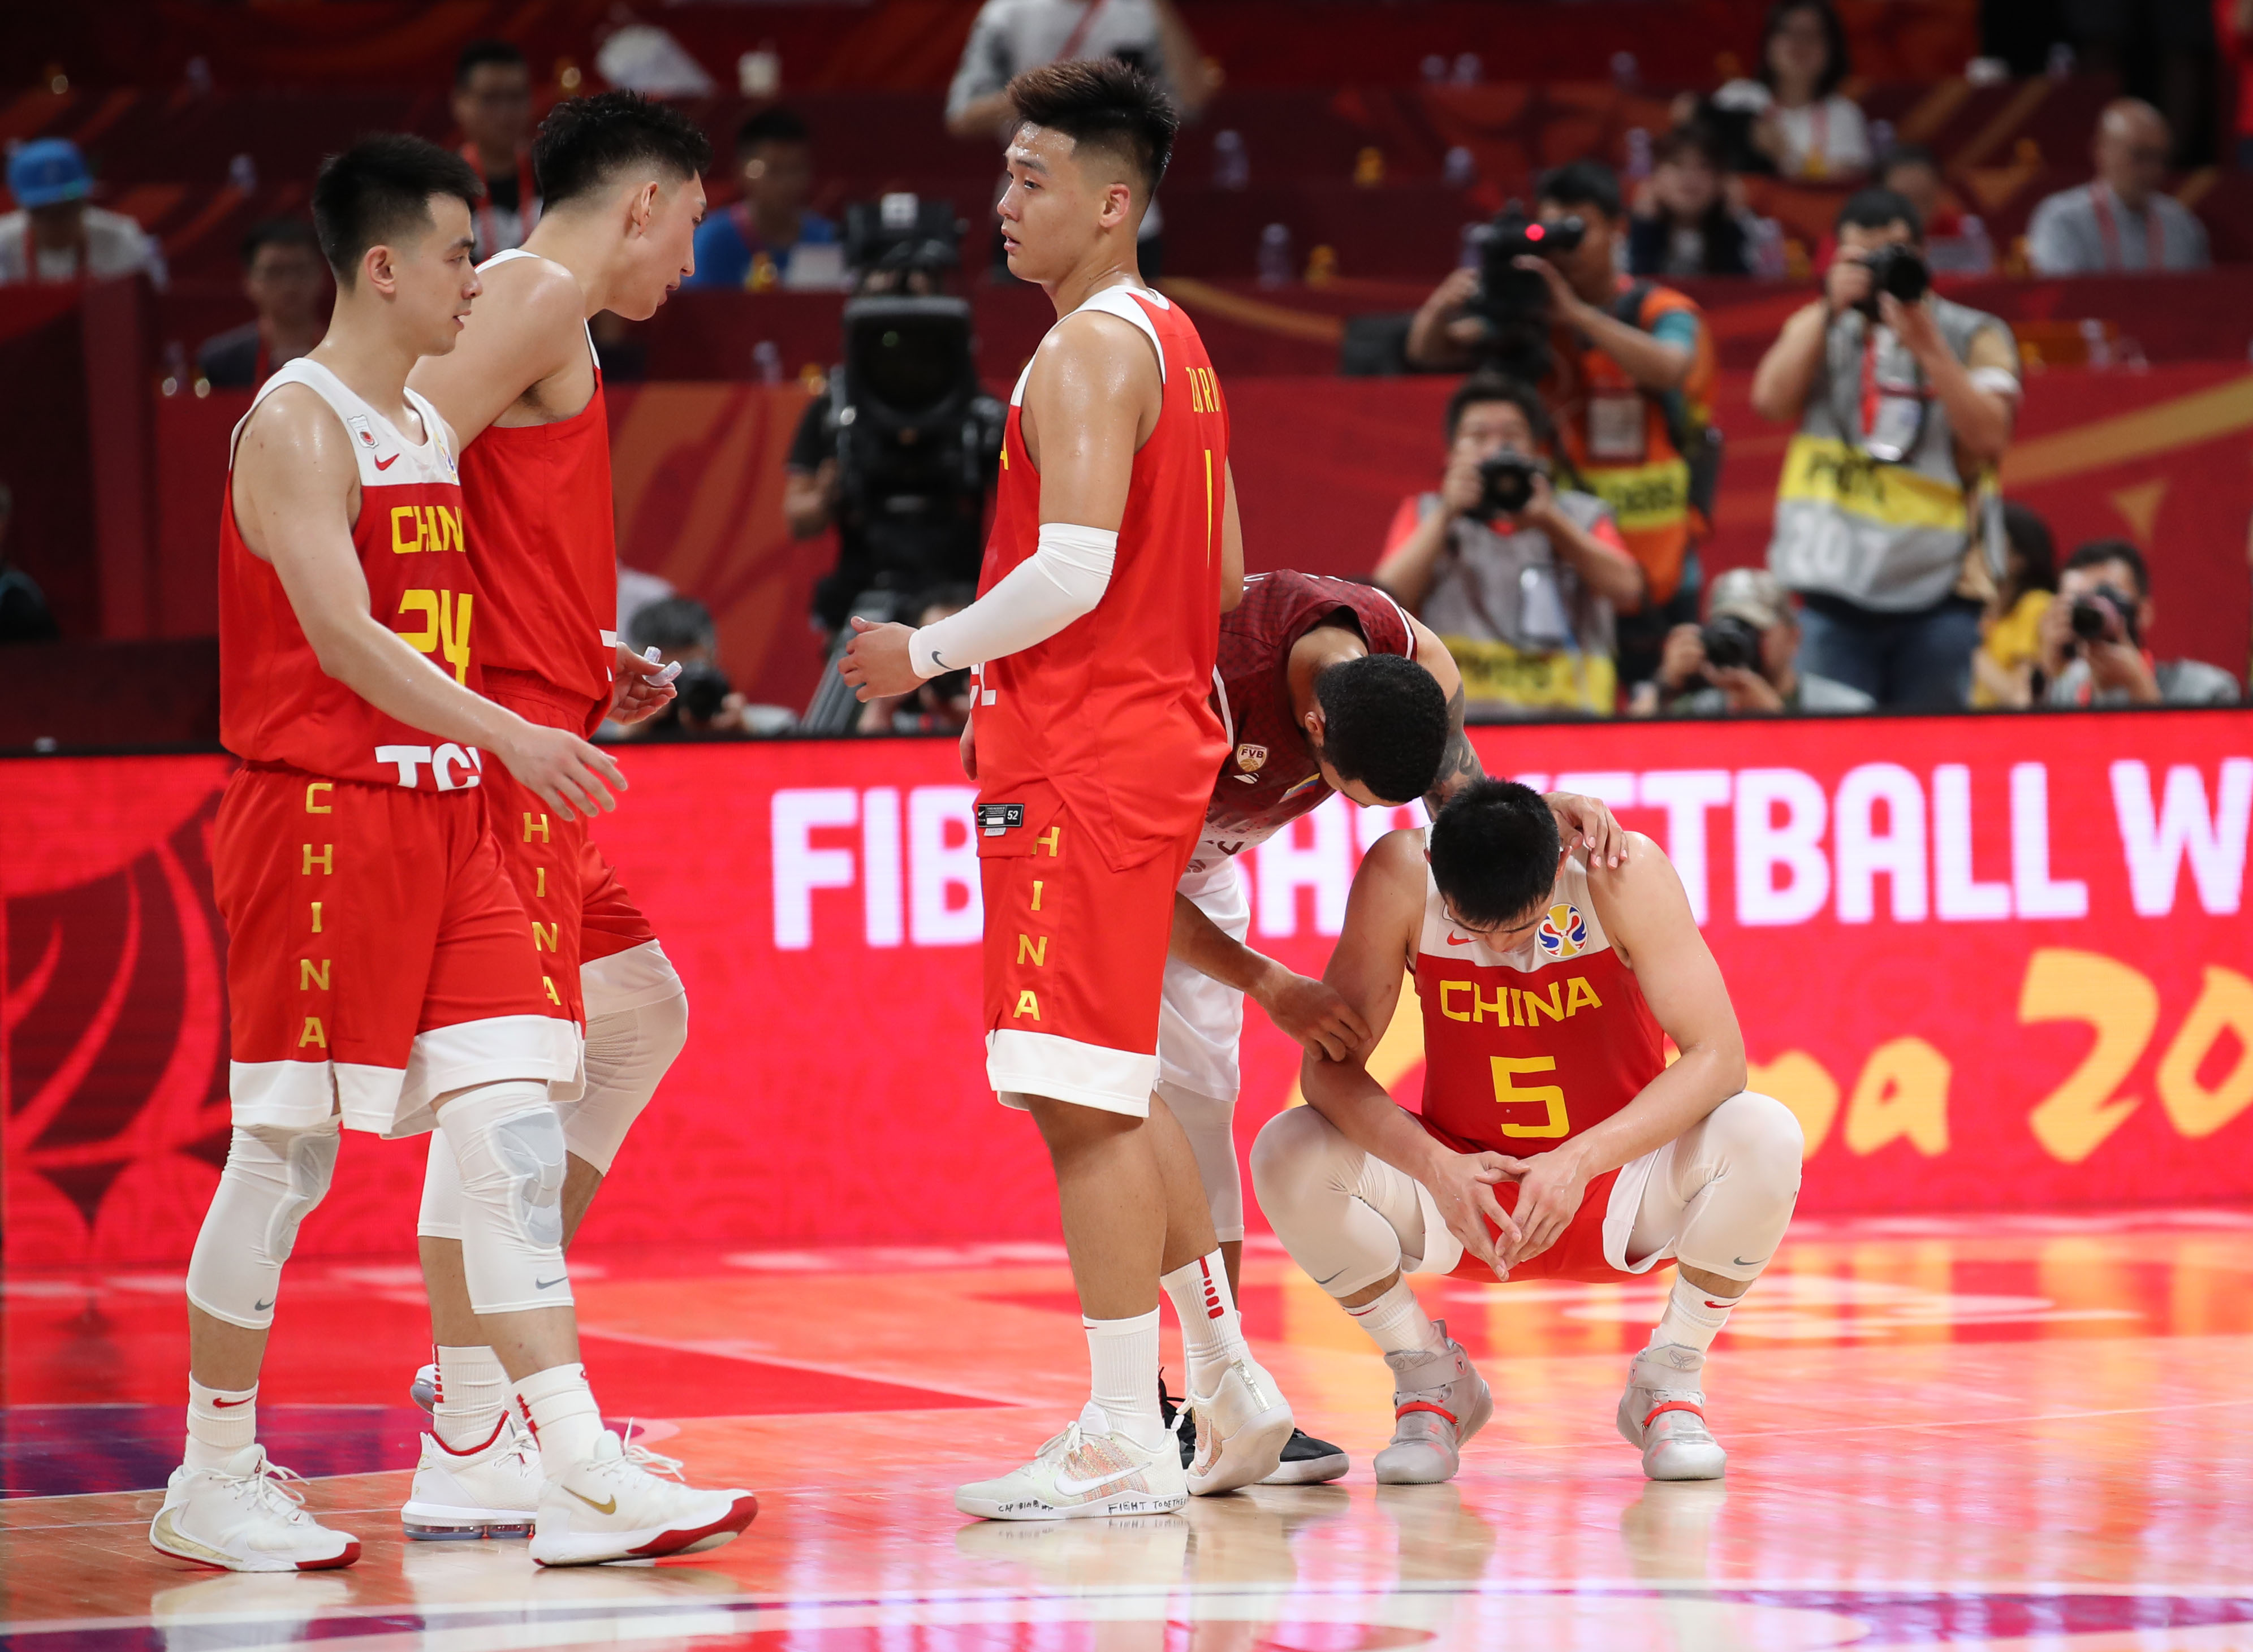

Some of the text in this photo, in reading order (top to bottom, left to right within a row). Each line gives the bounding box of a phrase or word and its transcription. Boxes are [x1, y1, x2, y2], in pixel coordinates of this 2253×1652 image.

[391, 505, 467, 554] CHIN
[1205, 449, 1212, 569] 1
[396, 589, 473, 685] 24
[374, 743, 482, 792] TC
[1241, 749, 1264, 758] FVB
[1007, 810, 1018, 820] 52
[298, 782, 334, 1049] CHINA
[1439, 976, 1603, 1027] CHINA
[1489, 1055, 1570, 1139] 5
[1107, 1500, 1147, 1515] FIGHT
